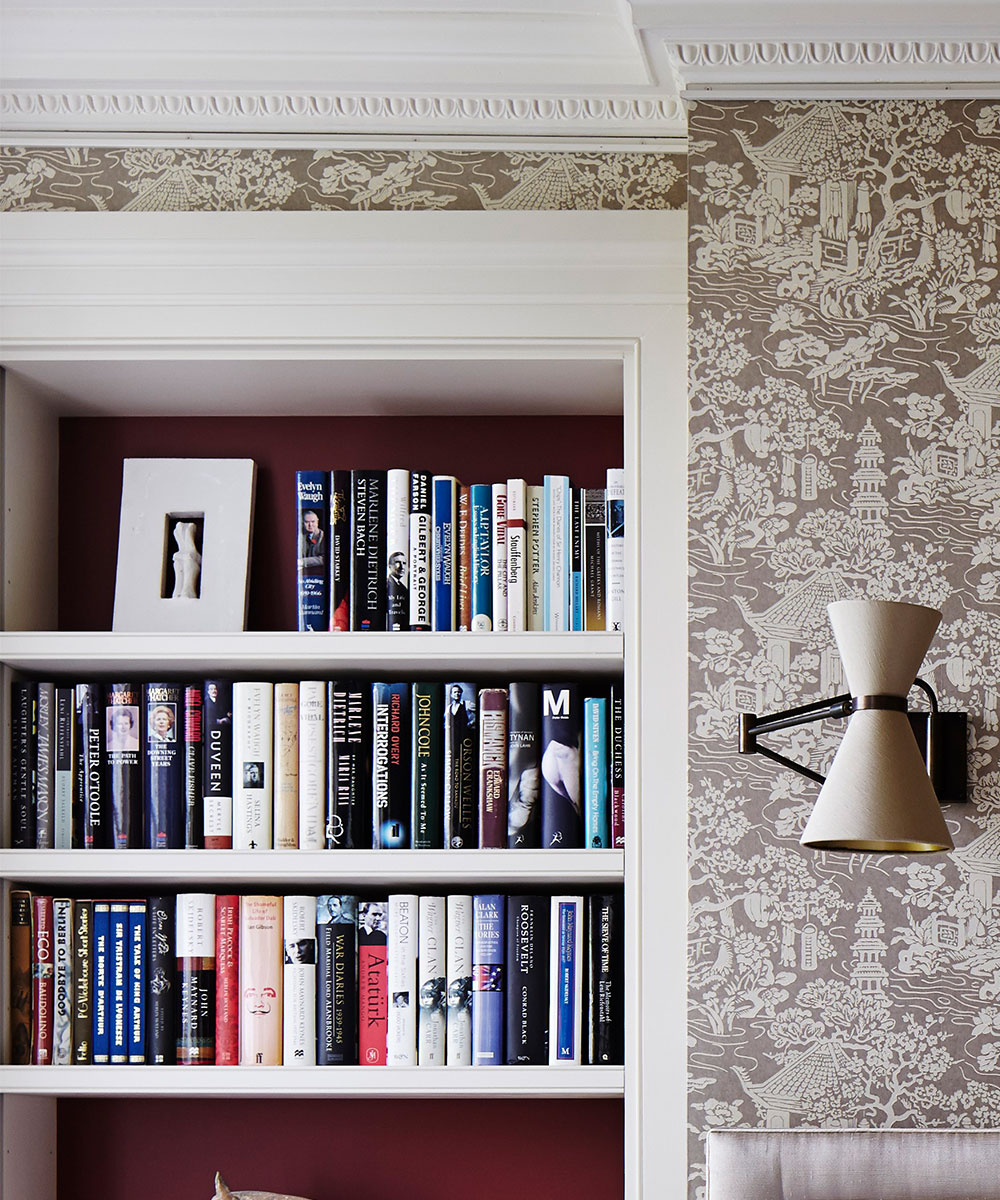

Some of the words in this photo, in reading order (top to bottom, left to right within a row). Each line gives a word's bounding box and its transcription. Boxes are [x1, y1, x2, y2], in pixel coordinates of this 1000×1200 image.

[298, 482, 322, 493] Evelyn
[299, 492, 323, 503] Waugh
[356, 478, 366, 520] STEVEN
[367, 478, 378, 542] MARLENE
[496, 495, 507, 519] GORE
[356, 525, 366, 556] BACH
[418, 516, 426, 562] GILBERT
[443, 522, 451, 554] EVELYN
[496, 521, 507, 545] VIDAL
[443, 554, 451, 584] WAUGH
[480, 530, 489, 576] TAYLOR
[509, 536, 521, 583] Stauffenberg
[367, 546, 378, 610] DIETRICH
[418, 577, 426, 622] GEORGE
[38, 688, 49, 729] MORLEY
[333, 692, 346, 742] DIETRICH
[348, 692, 362, 743] MARLENE
[391, 694, 400, 733] RICHARD
[416, 694, 430, 726] JOHN
[544, 690, 569, 716] M
[38, 734, 49, 773] JAMES
[89, 729, 100, 769] PETER
[391, 736, 400, 765] OVERY
[416, 728, 430, 757] COLE
[482, 710, 505, 769] BISMARCK
[211, 730, 221, 791] DUVEEN
[376, 704, 388, 808] INTERROGATIONS
[420, 763, 427, 771] As
[462, 738, 472, 781] ORSON
[592, 768, 600, 776] On
[38, 772, 49, 822] MASON
[89, 771, 100, 826] O'TOOLE
[494, 770, 502, 798] EDWARD
[420, 811, 427, 820] To
[462, 785, 472, 829] WELLES
[420, 823, 427, 833] Me
[77, 908, 88, 935] Stories
[399, 901, 408, 944] BEATON
[426, 903, 436, 934] Wagner
[454, 902, 464, 932] Wagner
[38, 931, 49, 960] ECO
[58, 948, 66, 962] TO
[77, 936, 88, 957] Short
[336, 935, 344, 959] WAR
[428, 937, 437, 973] CLAN
[454, 936, 464, 972] CLAN
[520, 904, 529, 974] ROOSEVELT
[601, 944, 609, 954] OF
[77, 959, 88, 1002] Wodehouse
[134, 968, 141, 979] OF
[336, 963, 344, 1005] DIARIES
[116, 990, 123, 1001] DE
[199, 989, 208, 1017] JOHN
[368, 954, 385, 1028] Atatürk
[77, 1040, 88, 1061] Folio
